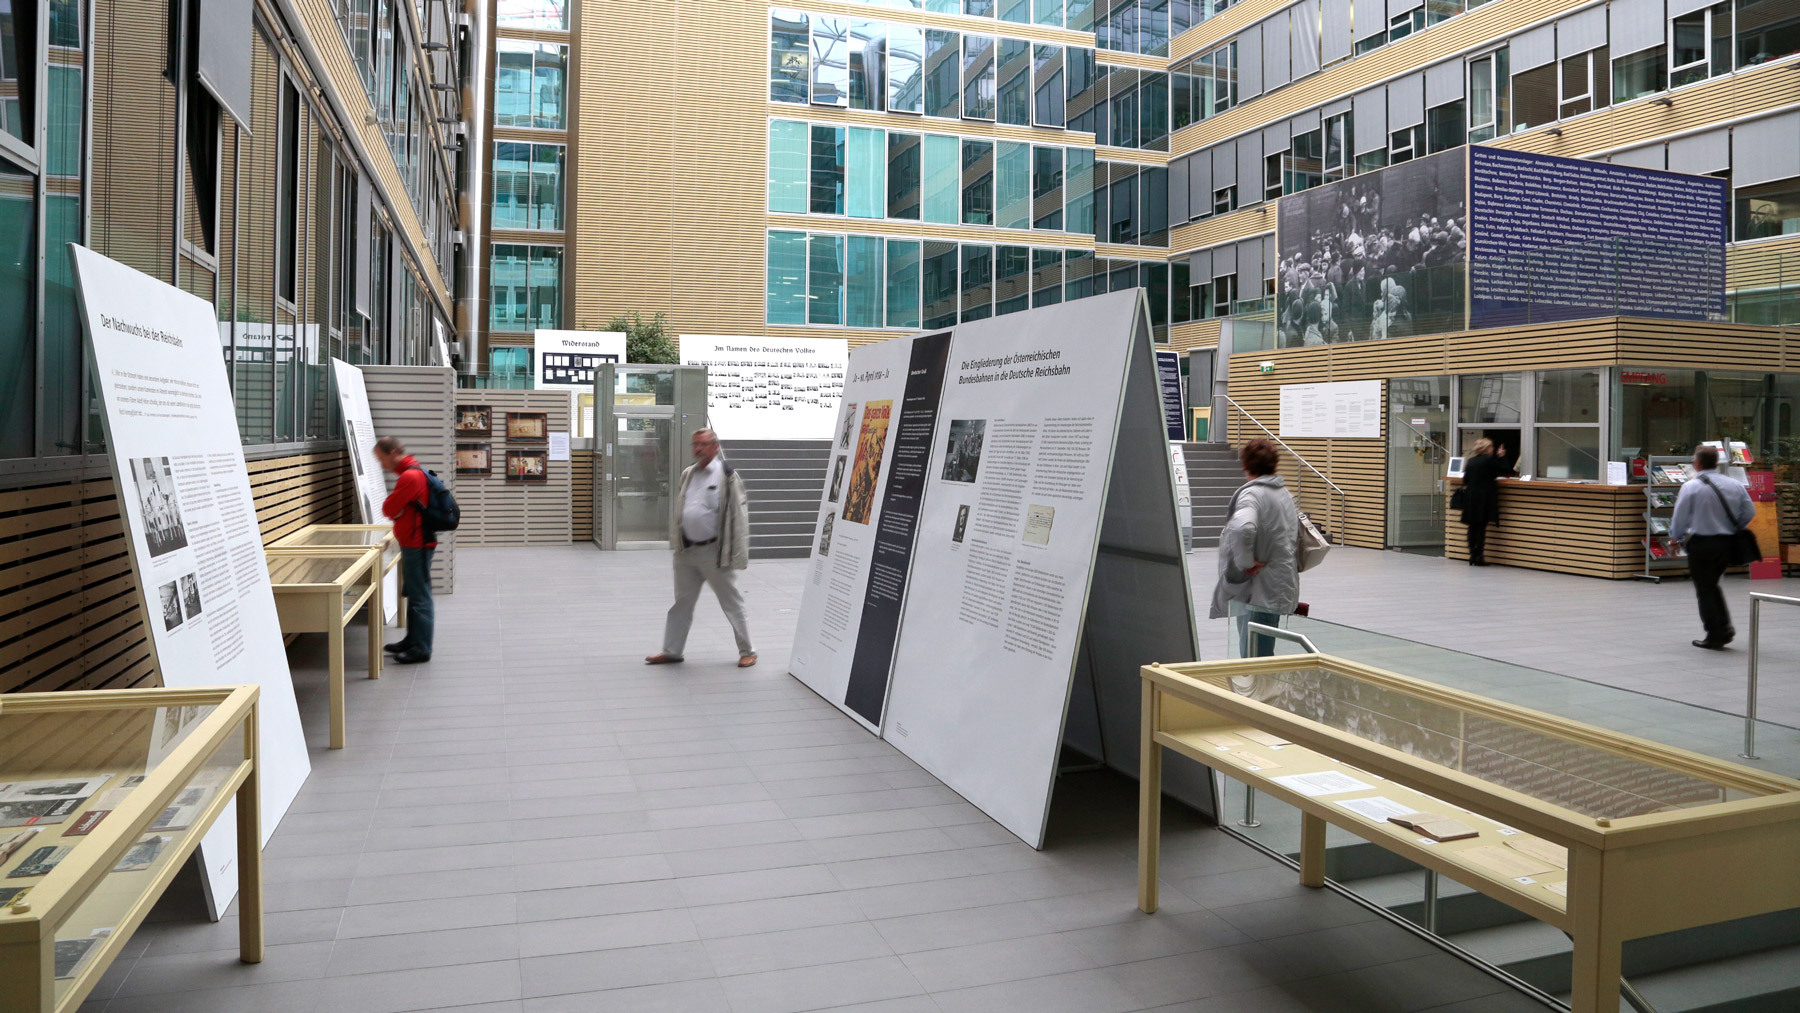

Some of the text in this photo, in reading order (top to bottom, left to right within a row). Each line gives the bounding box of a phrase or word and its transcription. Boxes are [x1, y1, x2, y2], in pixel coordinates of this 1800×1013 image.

[100, 313, 183, 348] Der Nachwuchs bei der Reichsbahn
[961, 349, 1060, 371] Die Eingliederung der Österreichischen
[959, 364, 1071, 384] Bundesbahnen in die Deutsche Reichsbahn
[1621, 370, 1667, 384] EMPFANG
